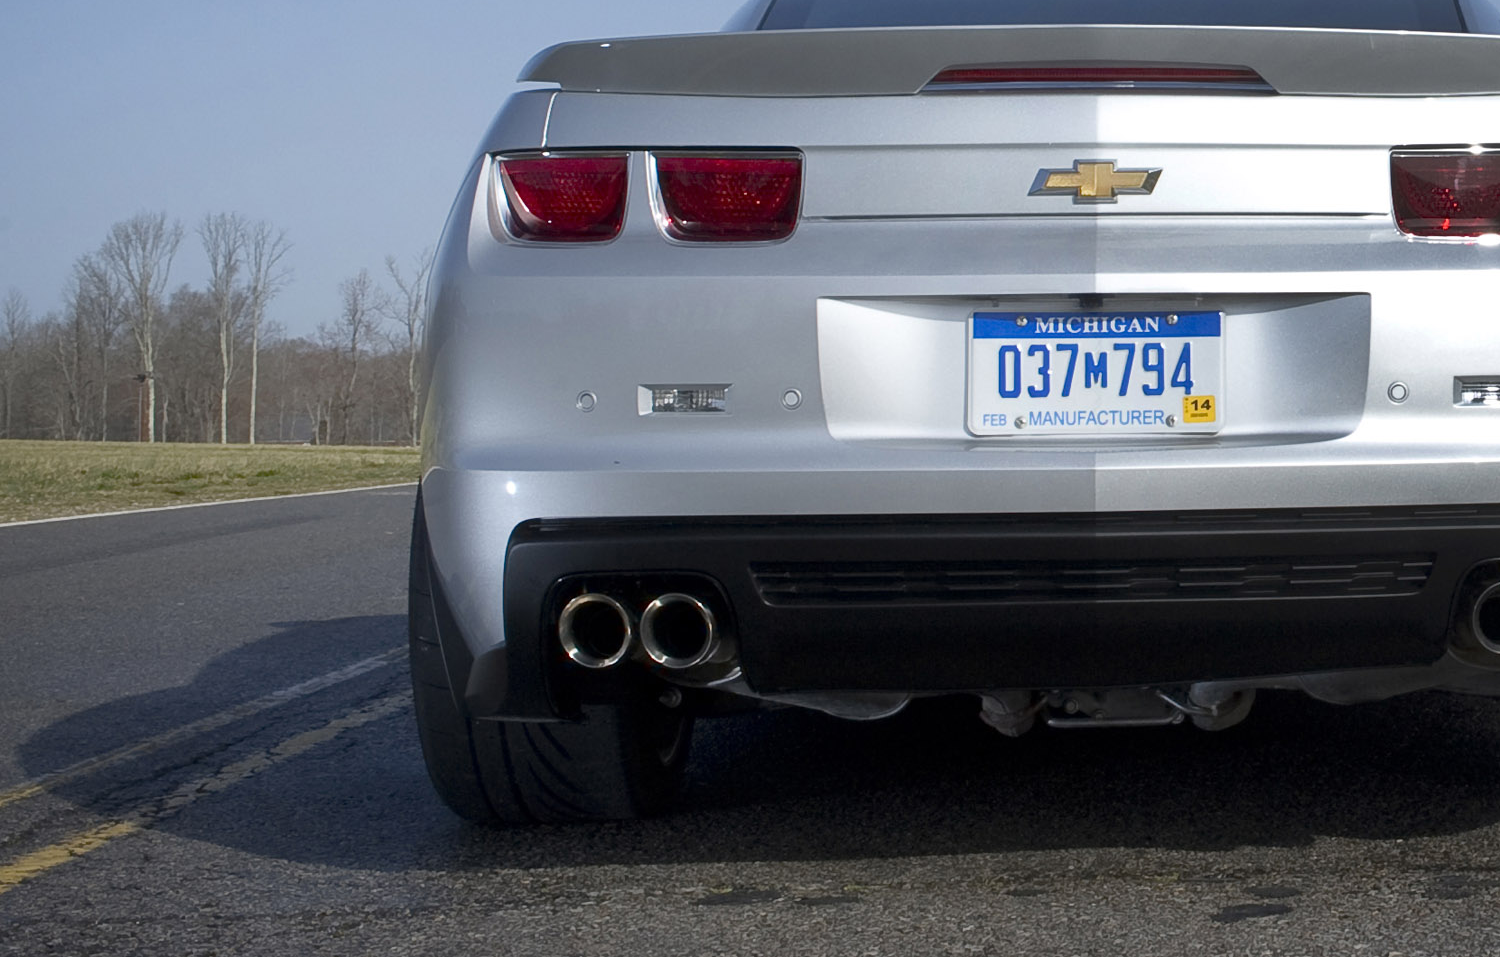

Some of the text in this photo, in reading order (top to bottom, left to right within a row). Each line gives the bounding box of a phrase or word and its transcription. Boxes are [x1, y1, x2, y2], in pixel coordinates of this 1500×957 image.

[1034, 316, 1160, 334] MICHIGAN
[998, 342, 1194, 398] 037M794
[1190, 399, 1212, 411] 14
[982, 413, 1008, 427] FEB
[1028, 410, 1165, 427] MANUFACTURER
